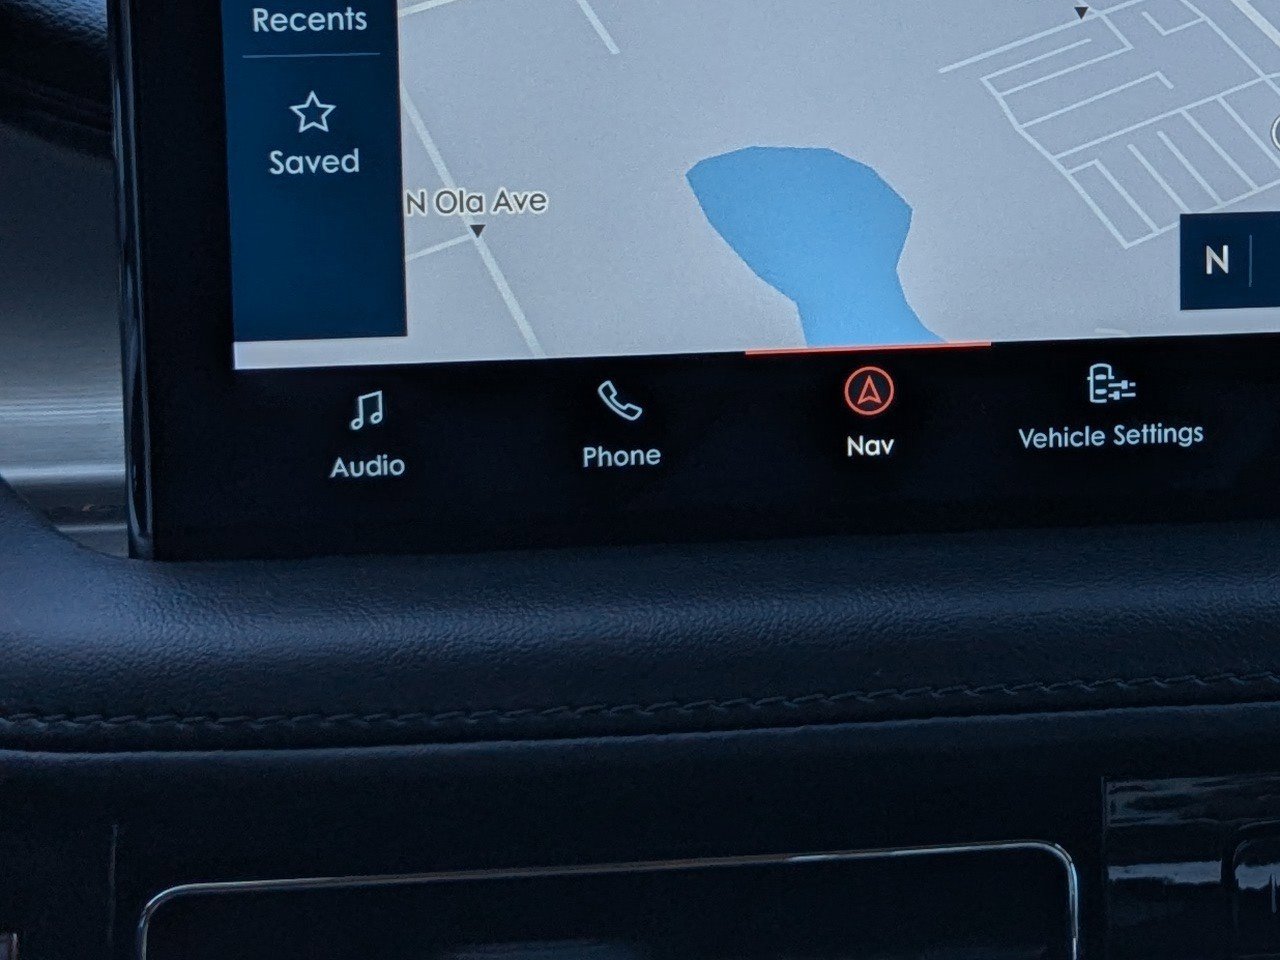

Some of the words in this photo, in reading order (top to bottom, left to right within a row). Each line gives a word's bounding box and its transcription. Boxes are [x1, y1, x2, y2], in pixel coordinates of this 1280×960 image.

[251, 5, 369, 34] Recents
[268, 146, 361, 176] Saved
[407, 191, 426, 214] N
[434, 189, 484, 215] Ola
[493, 189, 548, 213] Ave
[1205, 244, 1230, 275] N
[846, 434, 897, 458] Nav
[1017, 425, 1105, 451] Vehicle
[1112, 420, 1205, 450] Settings
[329, 452, 407, 480] Audio
[582, 443, 662, 470] Phone
